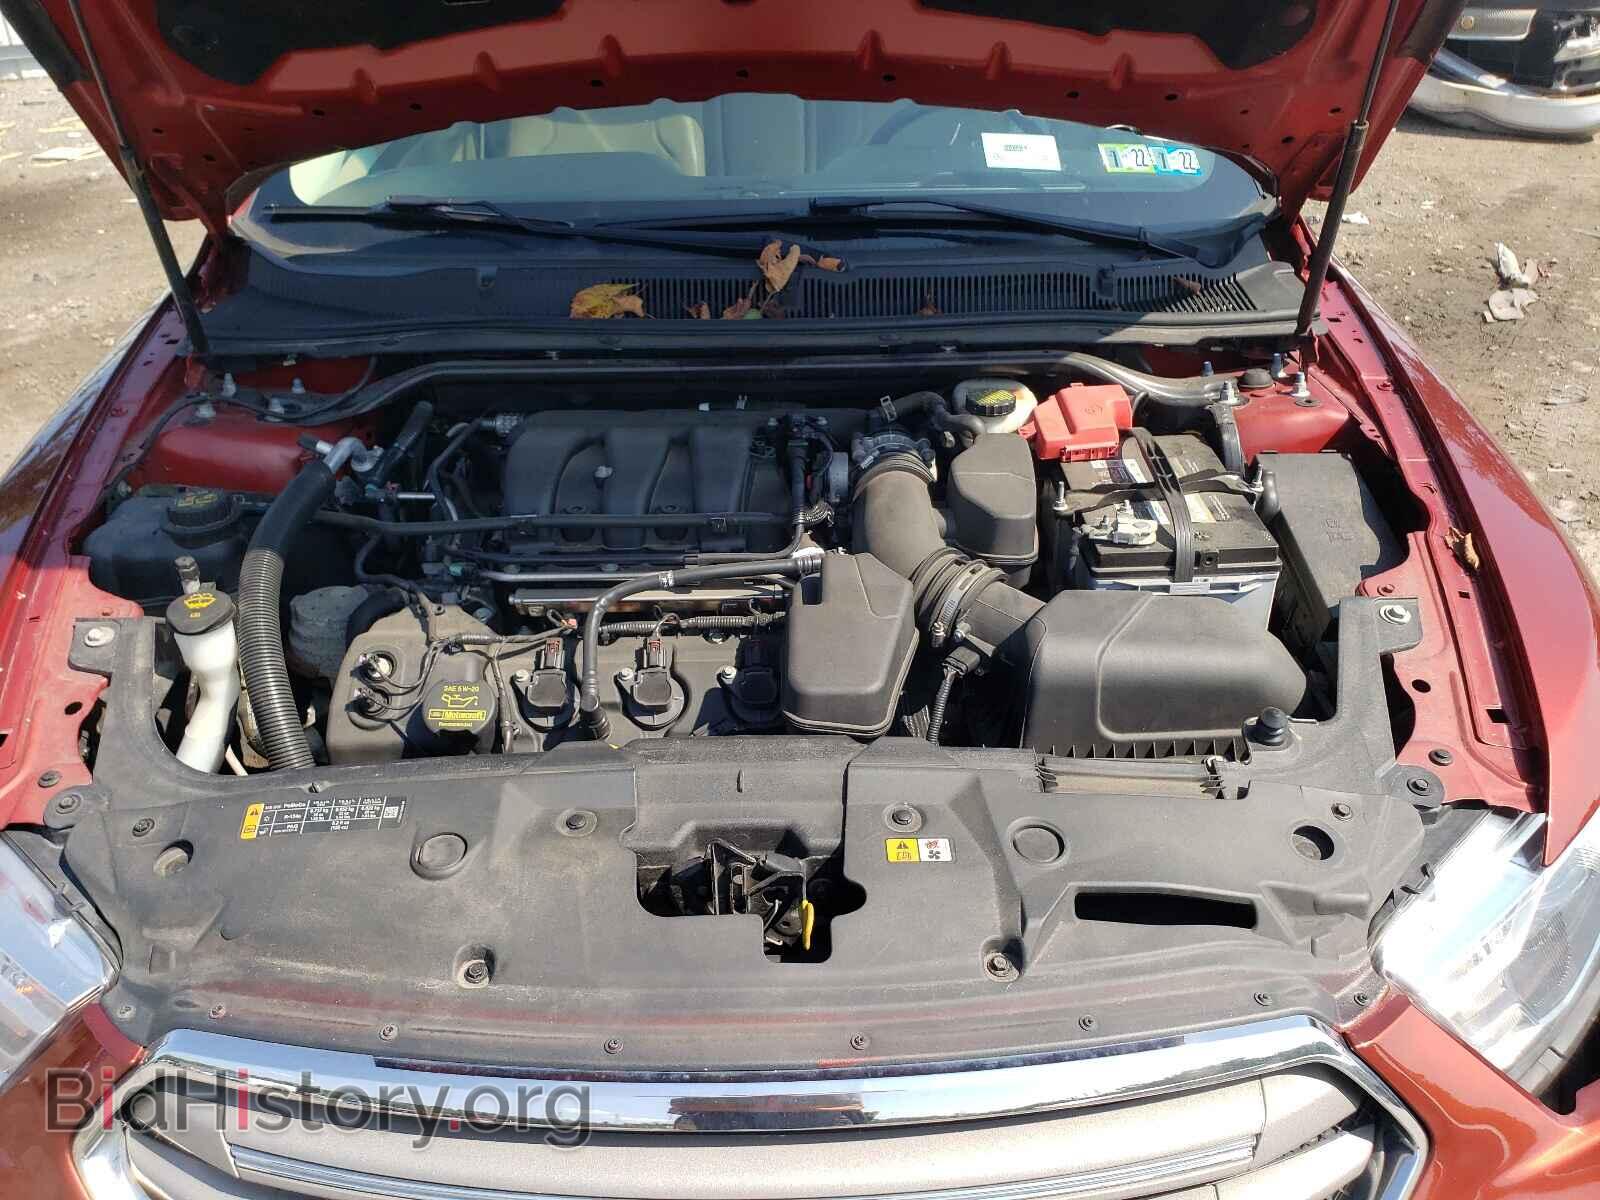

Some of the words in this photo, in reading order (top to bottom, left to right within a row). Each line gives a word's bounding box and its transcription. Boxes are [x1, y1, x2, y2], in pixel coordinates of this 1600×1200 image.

[1131, 148, 1149, 167] 22
[1178, 151, 1196, 170] 22
[444, 711, 483, 719] Motorcraft
